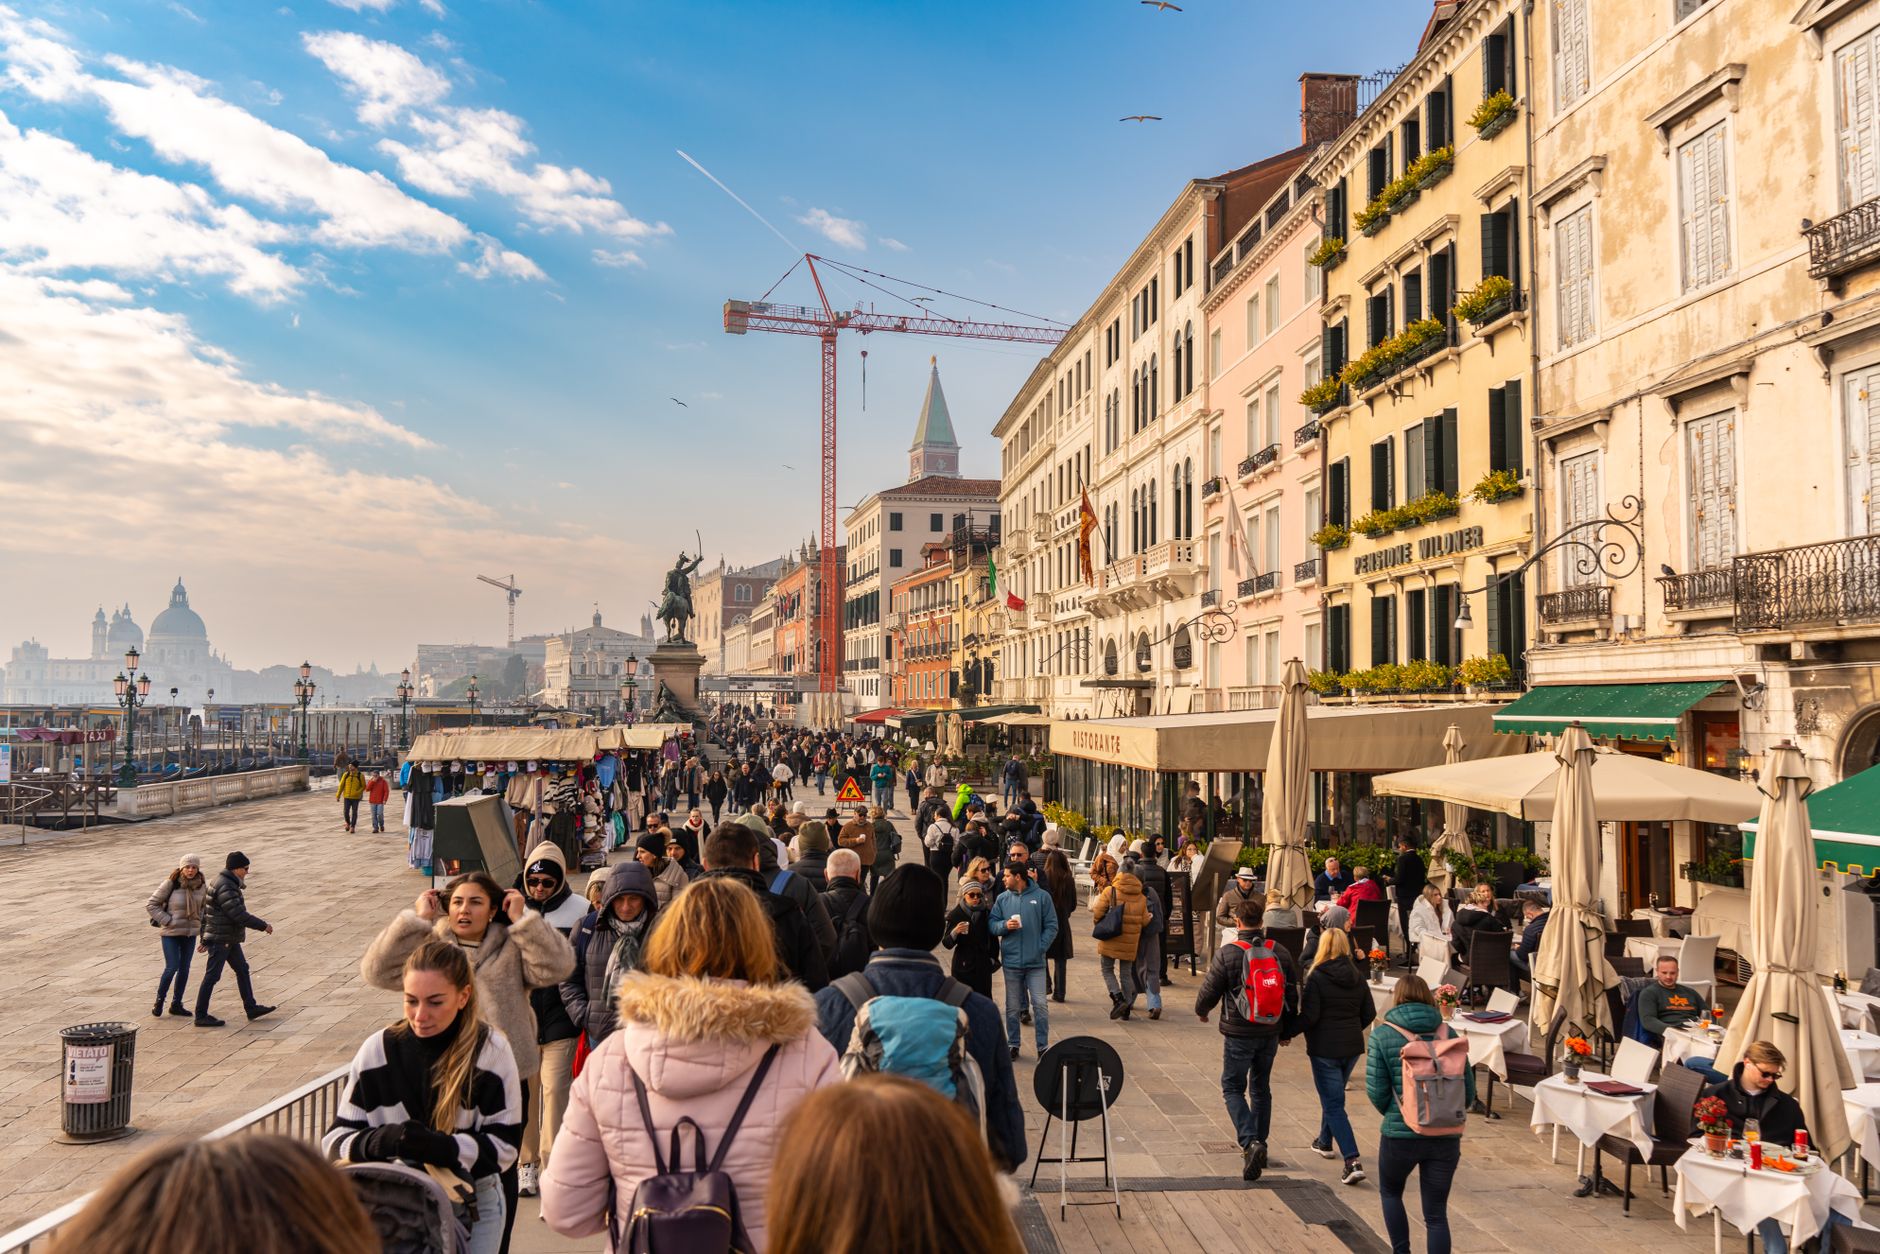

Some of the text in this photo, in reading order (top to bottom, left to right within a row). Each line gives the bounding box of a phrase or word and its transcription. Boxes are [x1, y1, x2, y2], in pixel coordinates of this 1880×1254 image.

[1354, 525, 1484, 575] PENSIONE WILDNER
[1072, 730, 1121, 754] RISTORANTE
[67, 1046, 108, 1058] VIETATO
